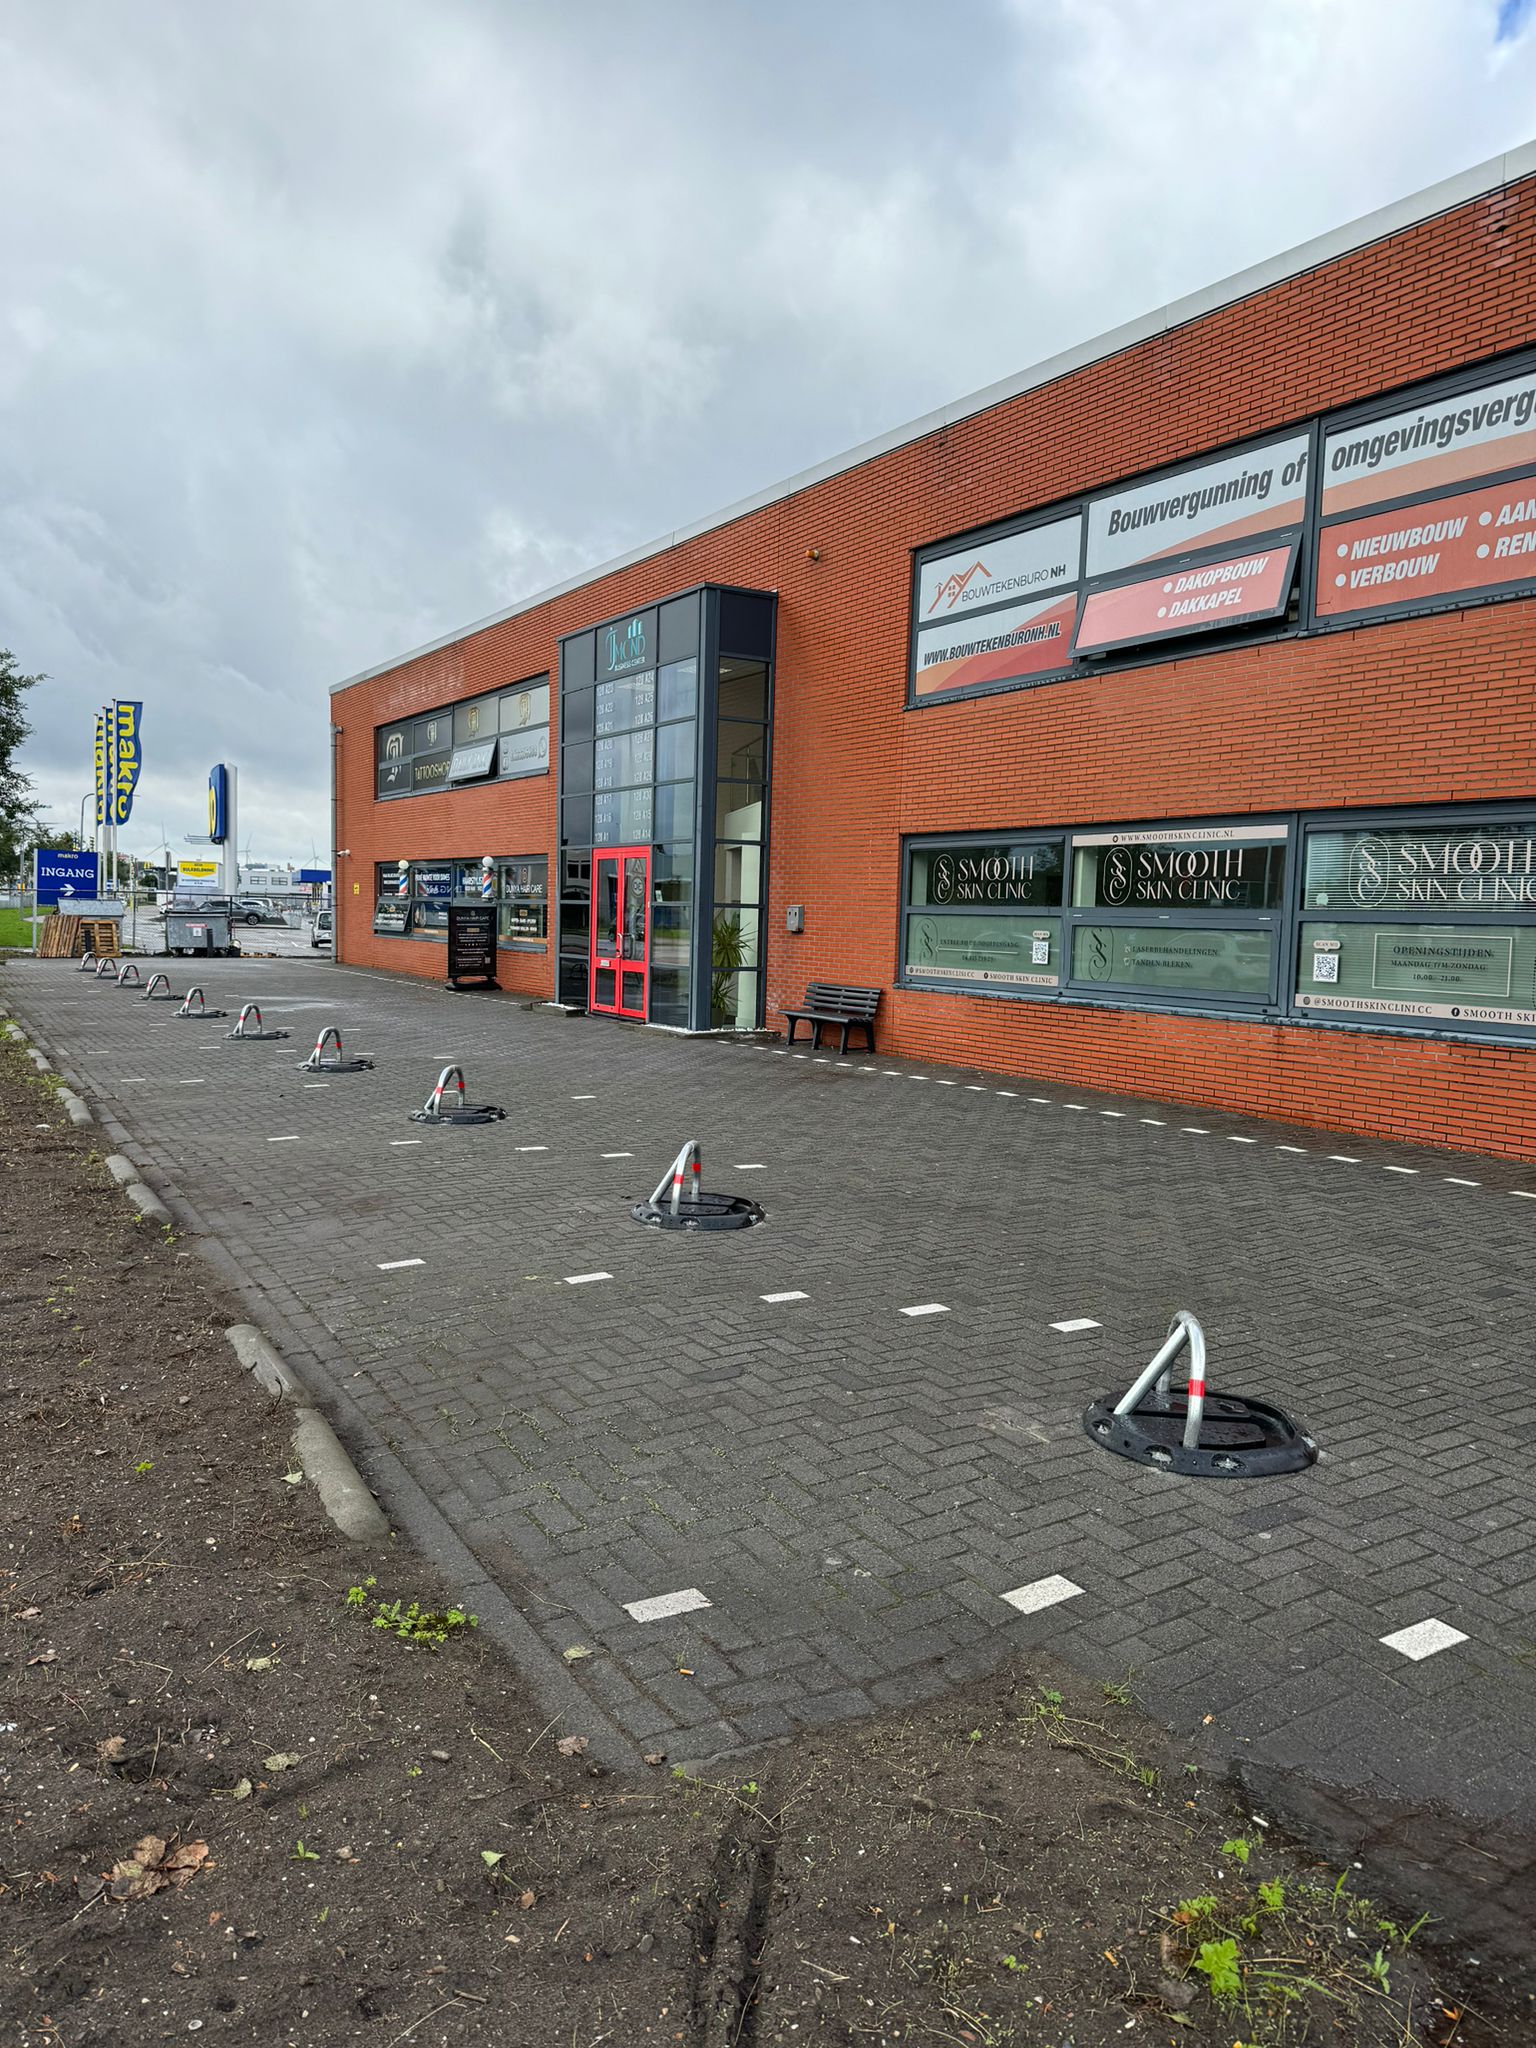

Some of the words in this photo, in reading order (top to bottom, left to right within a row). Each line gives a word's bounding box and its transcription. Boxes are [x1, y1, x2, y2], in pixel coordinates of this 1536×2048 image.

[1332, 389, 1536, 472] omgevingsverg
[1108, 469, 1273, 537] Bouwvergunning
[1281, 452, 1308, 487] of
[1350, 516, 1469, 561] NIEUWBOUW
[962, 569, 1049, 602] BOUWTEKENBURO
[1050, 564, 1066, 579] NH
[1174, 556, 1269, 594] DAKOPBOUW
[1350, 553, 1440, 589] VERBOUW
[1168, 587, 1243, 618] DAKKAPEL
[924, 622, 1061, 666] WWW.BOUWTEKENBURONH.NL
[117, 705, 138, 818] makro
[1121, 830, 1235, 842] WWW.SMOOTHSKINCLINIC.NL
[41, 867, 94, 878] INGANG
[957, 855, 1034, 881] SMOOTH
[1137, 849, 1243, 879] SMOOTH
[957, 882, 984, 899] SKIN
[987, 882, 1032, 899] CLINIC
[1136, 880, 1173, 900] SKIN
[1178, 879, 1241, 900] CLINIC
[1396, 878, 1448, 901] SKIN
[989, 973, 1014, 982] SMOOTH
[1015, 975, 1029, 983] SKIN
[1030, 976, 1053, 984] CLINIC
[1391, 960, 1431, 968] MAANDAG
[1463, 1008, 1512, 1020] SMOOTH
